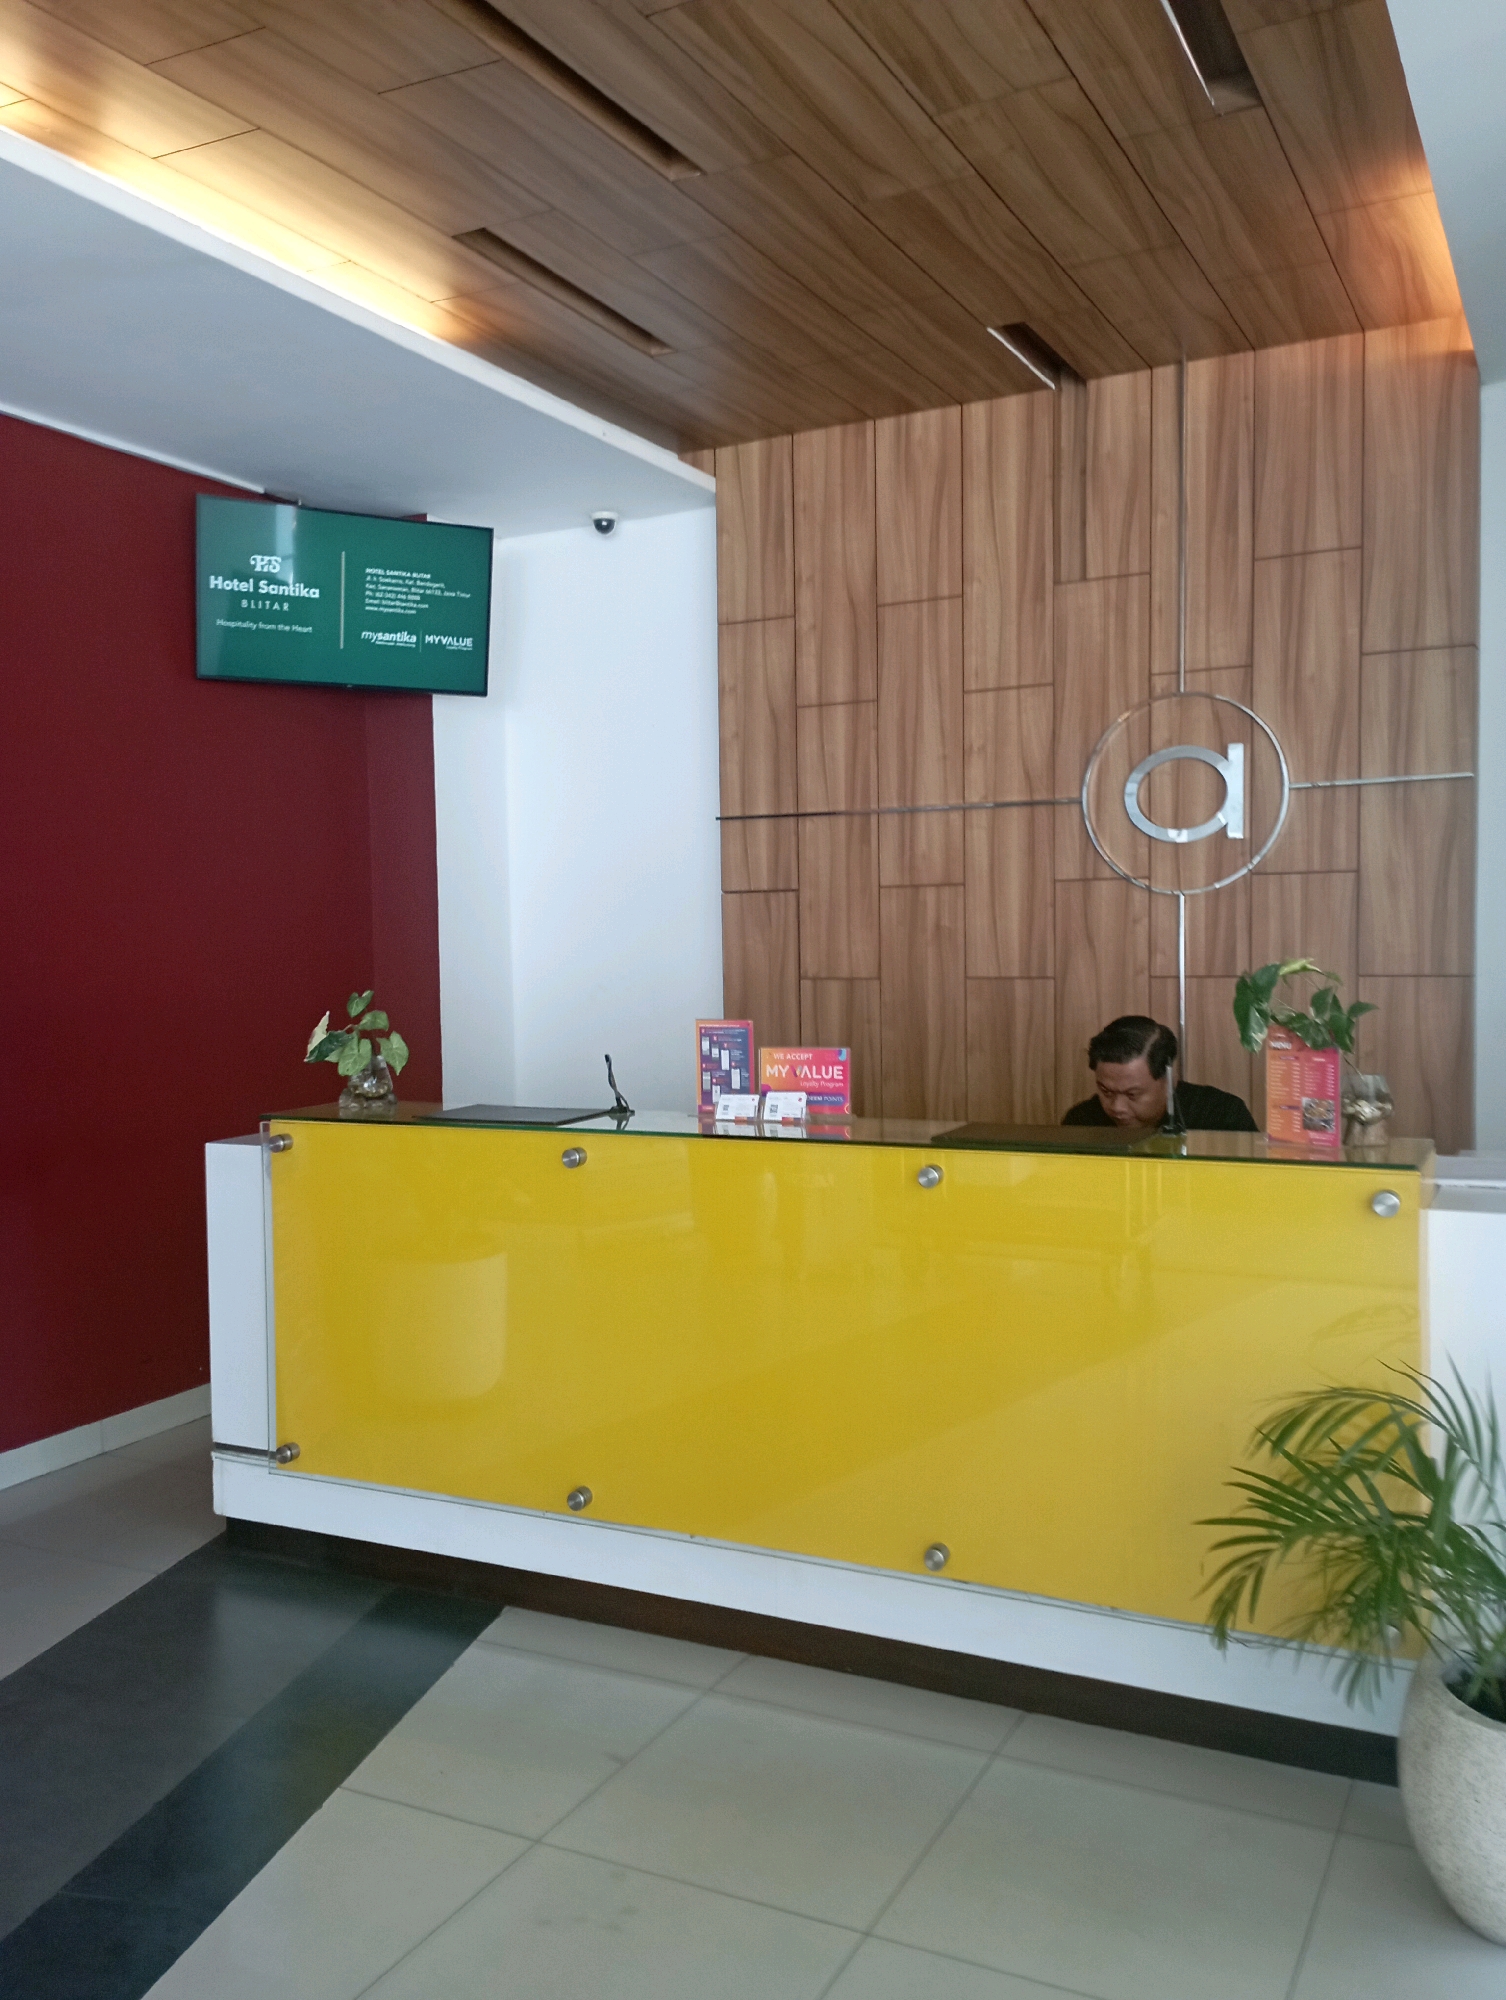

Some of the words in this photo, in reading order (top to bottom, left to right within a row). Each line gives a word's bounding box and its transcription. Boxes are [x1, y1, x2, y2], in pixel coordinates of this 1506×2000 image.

[209, 575, 254, 592] Hotel
[258, 580, 320, 598] Santika
[241, 599, 290, 611] BLITAR
[216, 619, 257, 631] Hospitality
[258, 622, 277, 630] from
[278, 624, 291, 632] the
[291, 625, 312, 633] Heart
[361, 631, 417, 643] mysantika
[766, 1064, 789, 1078] MY
[791, 1065, 844, 1080] VALUE
[800, 1081, 819, 1089] Loyalty
[820, 1081, 844, 1089] Program
